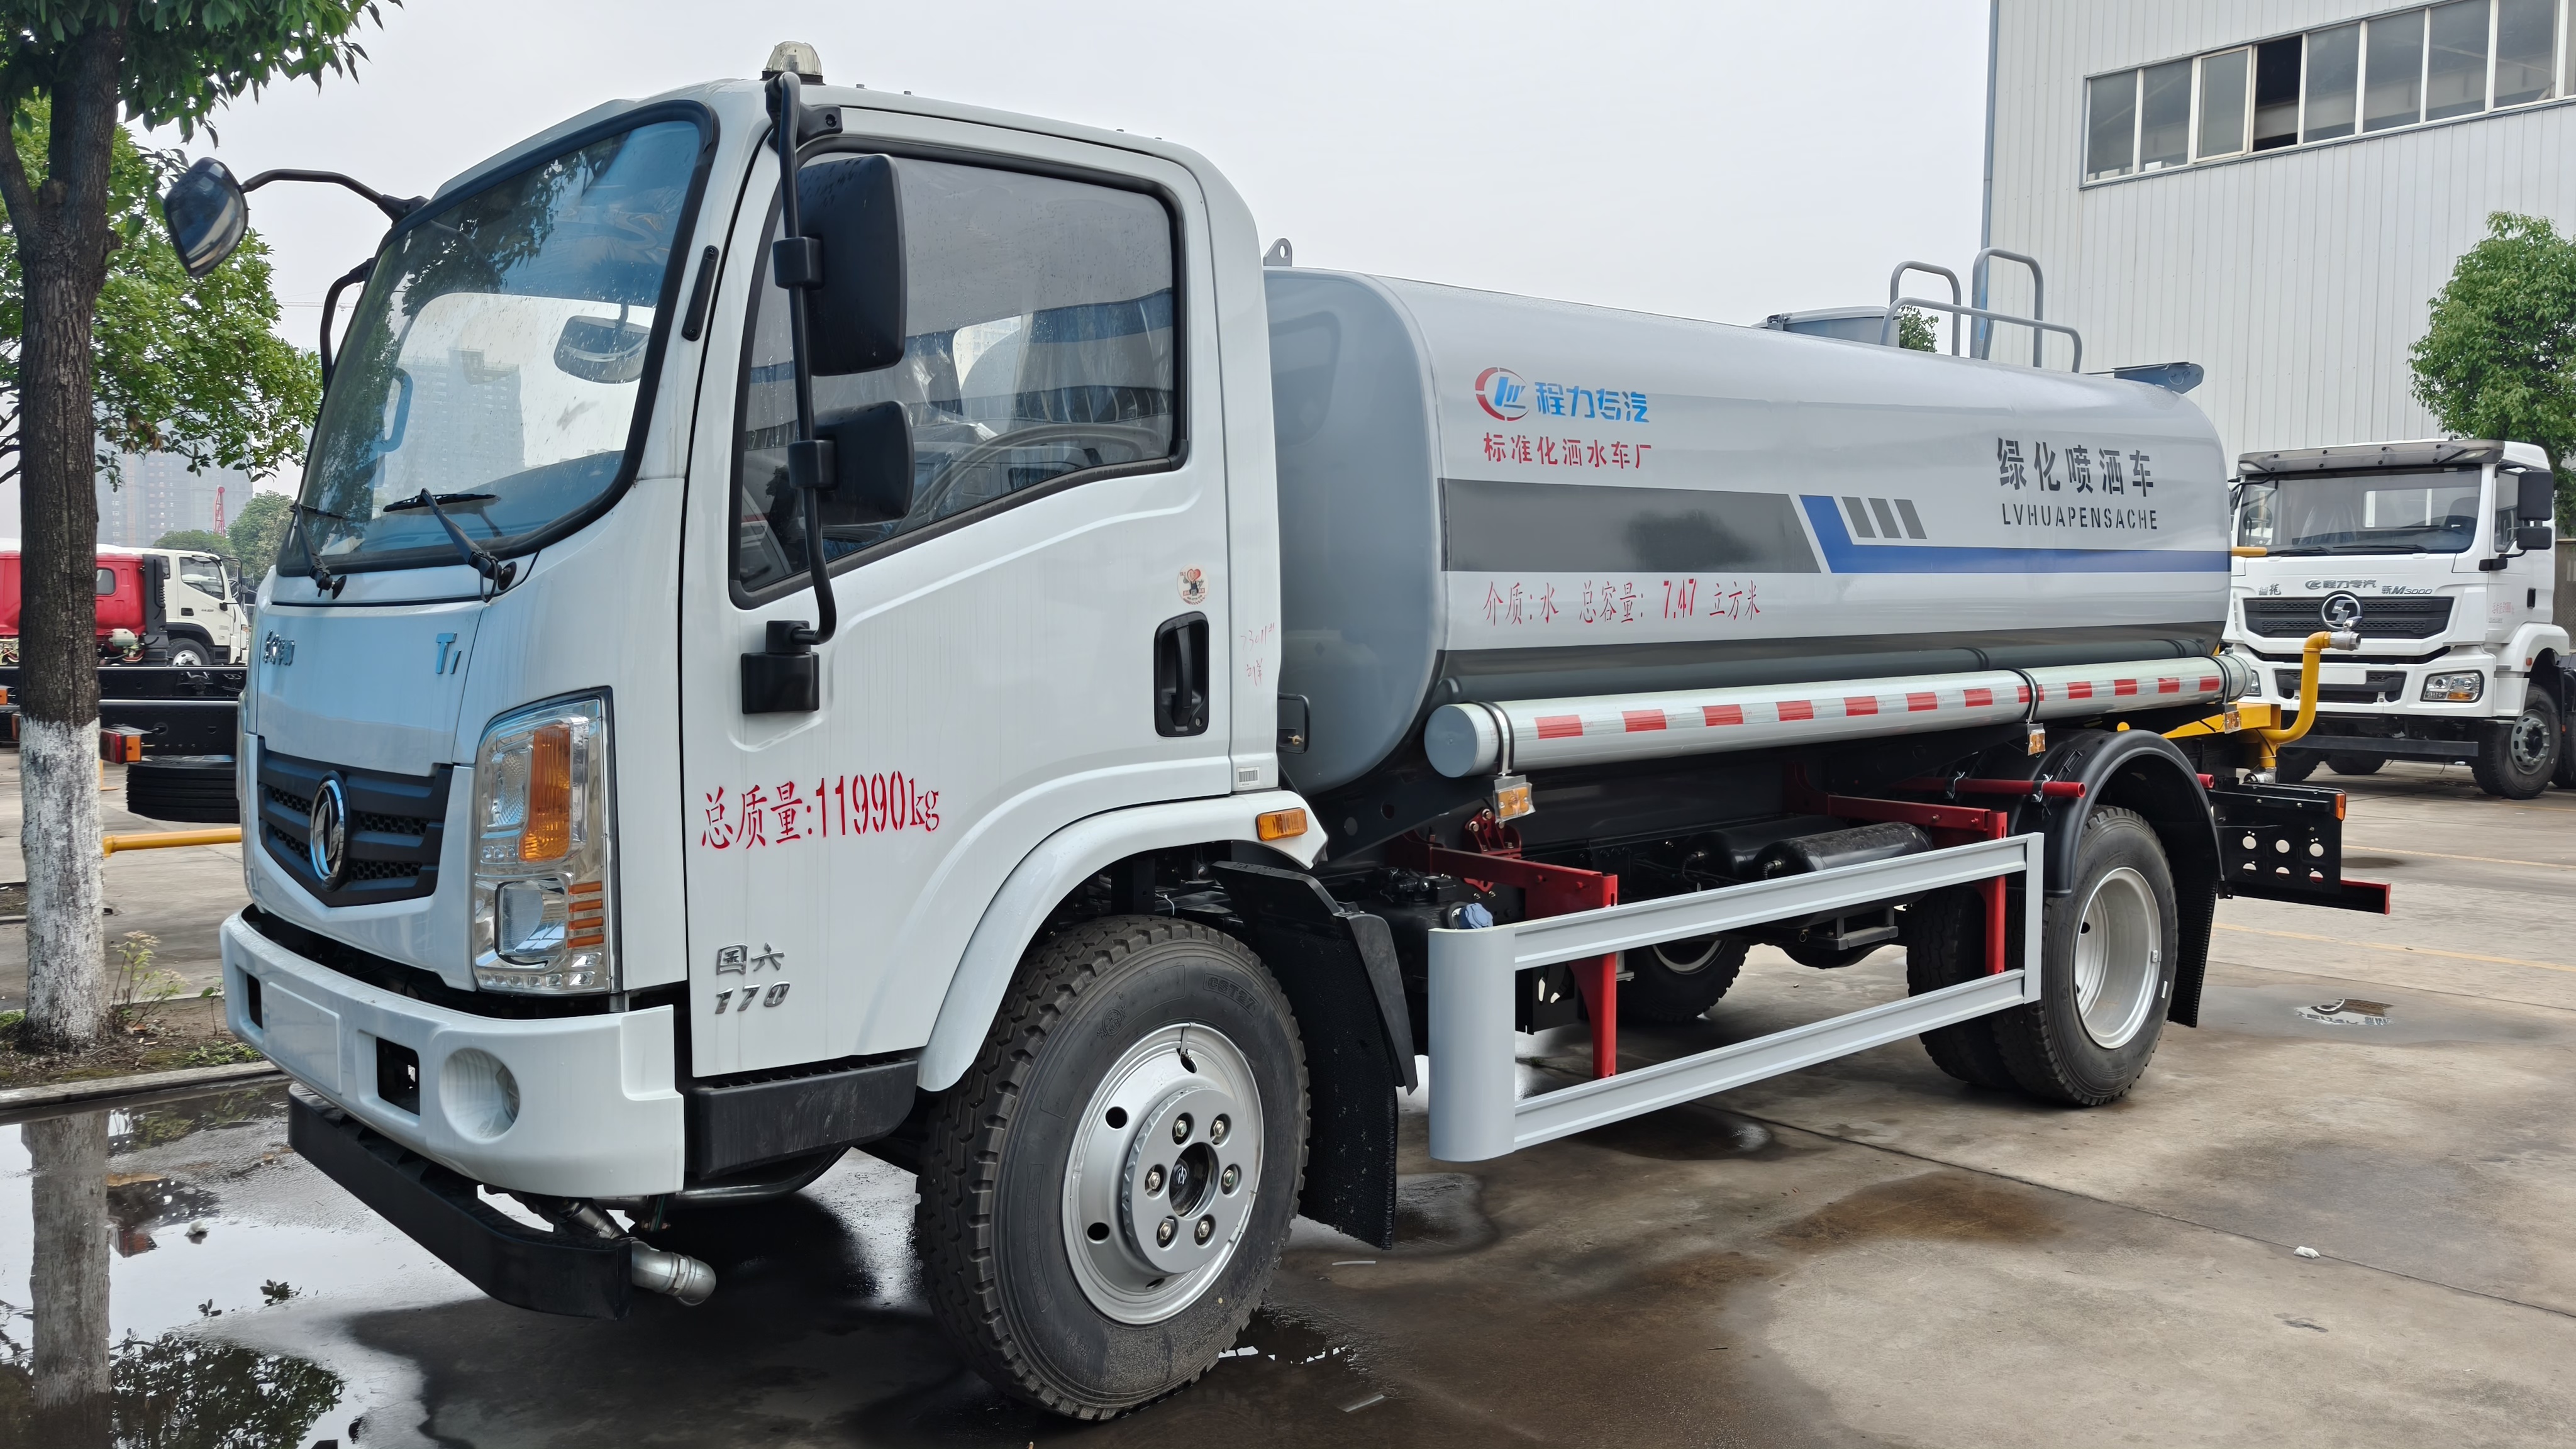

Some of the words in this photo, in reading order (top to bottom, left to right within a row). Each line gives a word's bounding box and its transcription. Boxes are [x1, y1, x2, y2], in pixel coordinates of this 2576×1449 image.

[1535, 381, 1650, 423] 程力专汽
[1484, 432, 1652, 469] 标准化洒水车厂
[1997, 437, 2154, 497] 绿化喷洒车
[2002, 503, 2157, 530] LVHUAPENSACHE
[1663, 579, 1697, 619] 7.47
[1709, 580, 1760, 621] 立方米
[716, 942, 786, 975] 国六
[714, 981, 791, 1014] 170
